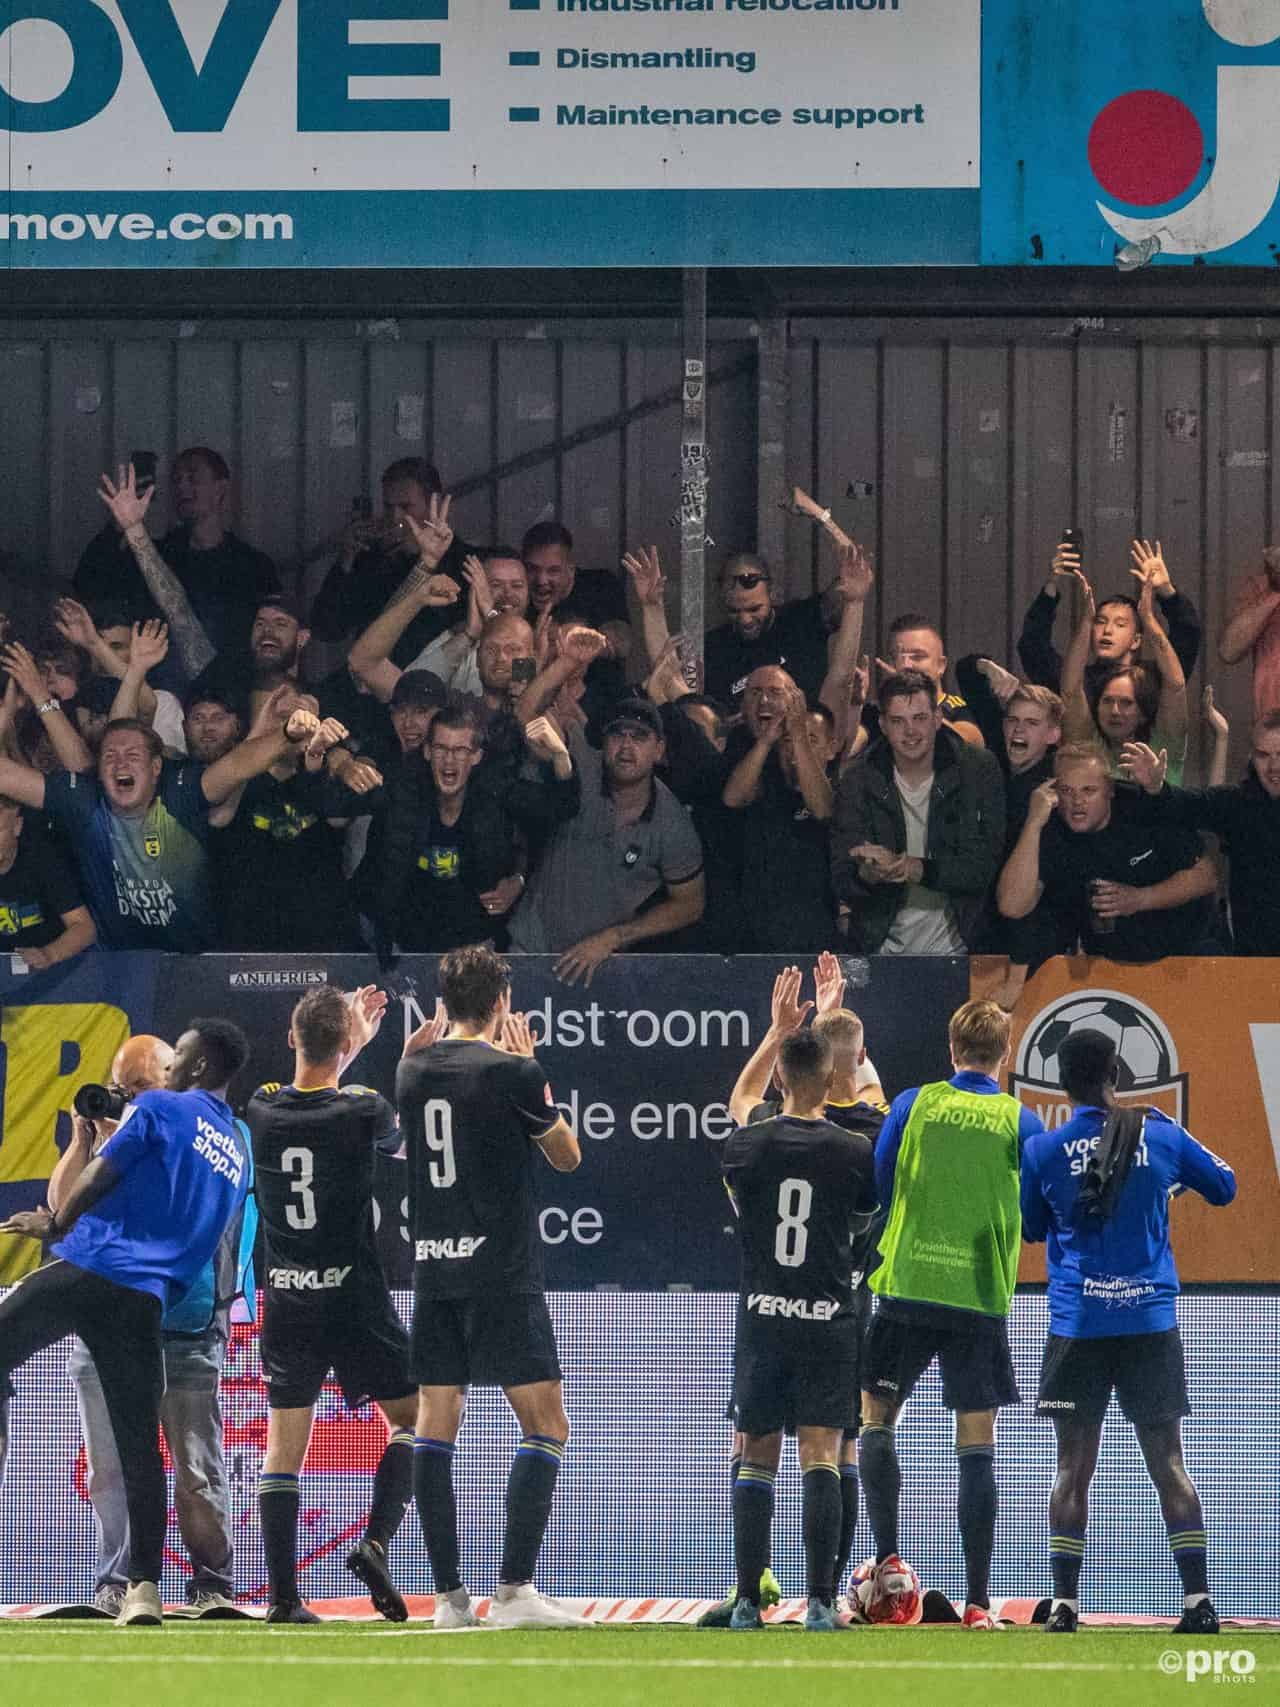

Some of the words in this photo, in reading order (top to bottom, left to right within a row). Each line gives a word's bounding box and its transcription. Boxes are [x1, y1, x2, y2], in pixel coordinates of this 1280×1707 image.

[556, 48, 757, 73] Dismantling
[556, 104, 782, 126] Maintenance
[792, 104, 925, 128] support
[192, 1135, 242, 1189] shop.nl
[424, 1099, 456, 1188] 9
[281, 1147, 318, 1230] 3
[775, 1178, 813, 1267] 8
[415, 1236, 488, 1261] ERKLEY
[747, 1293, 840, 1321] VERKLEY
